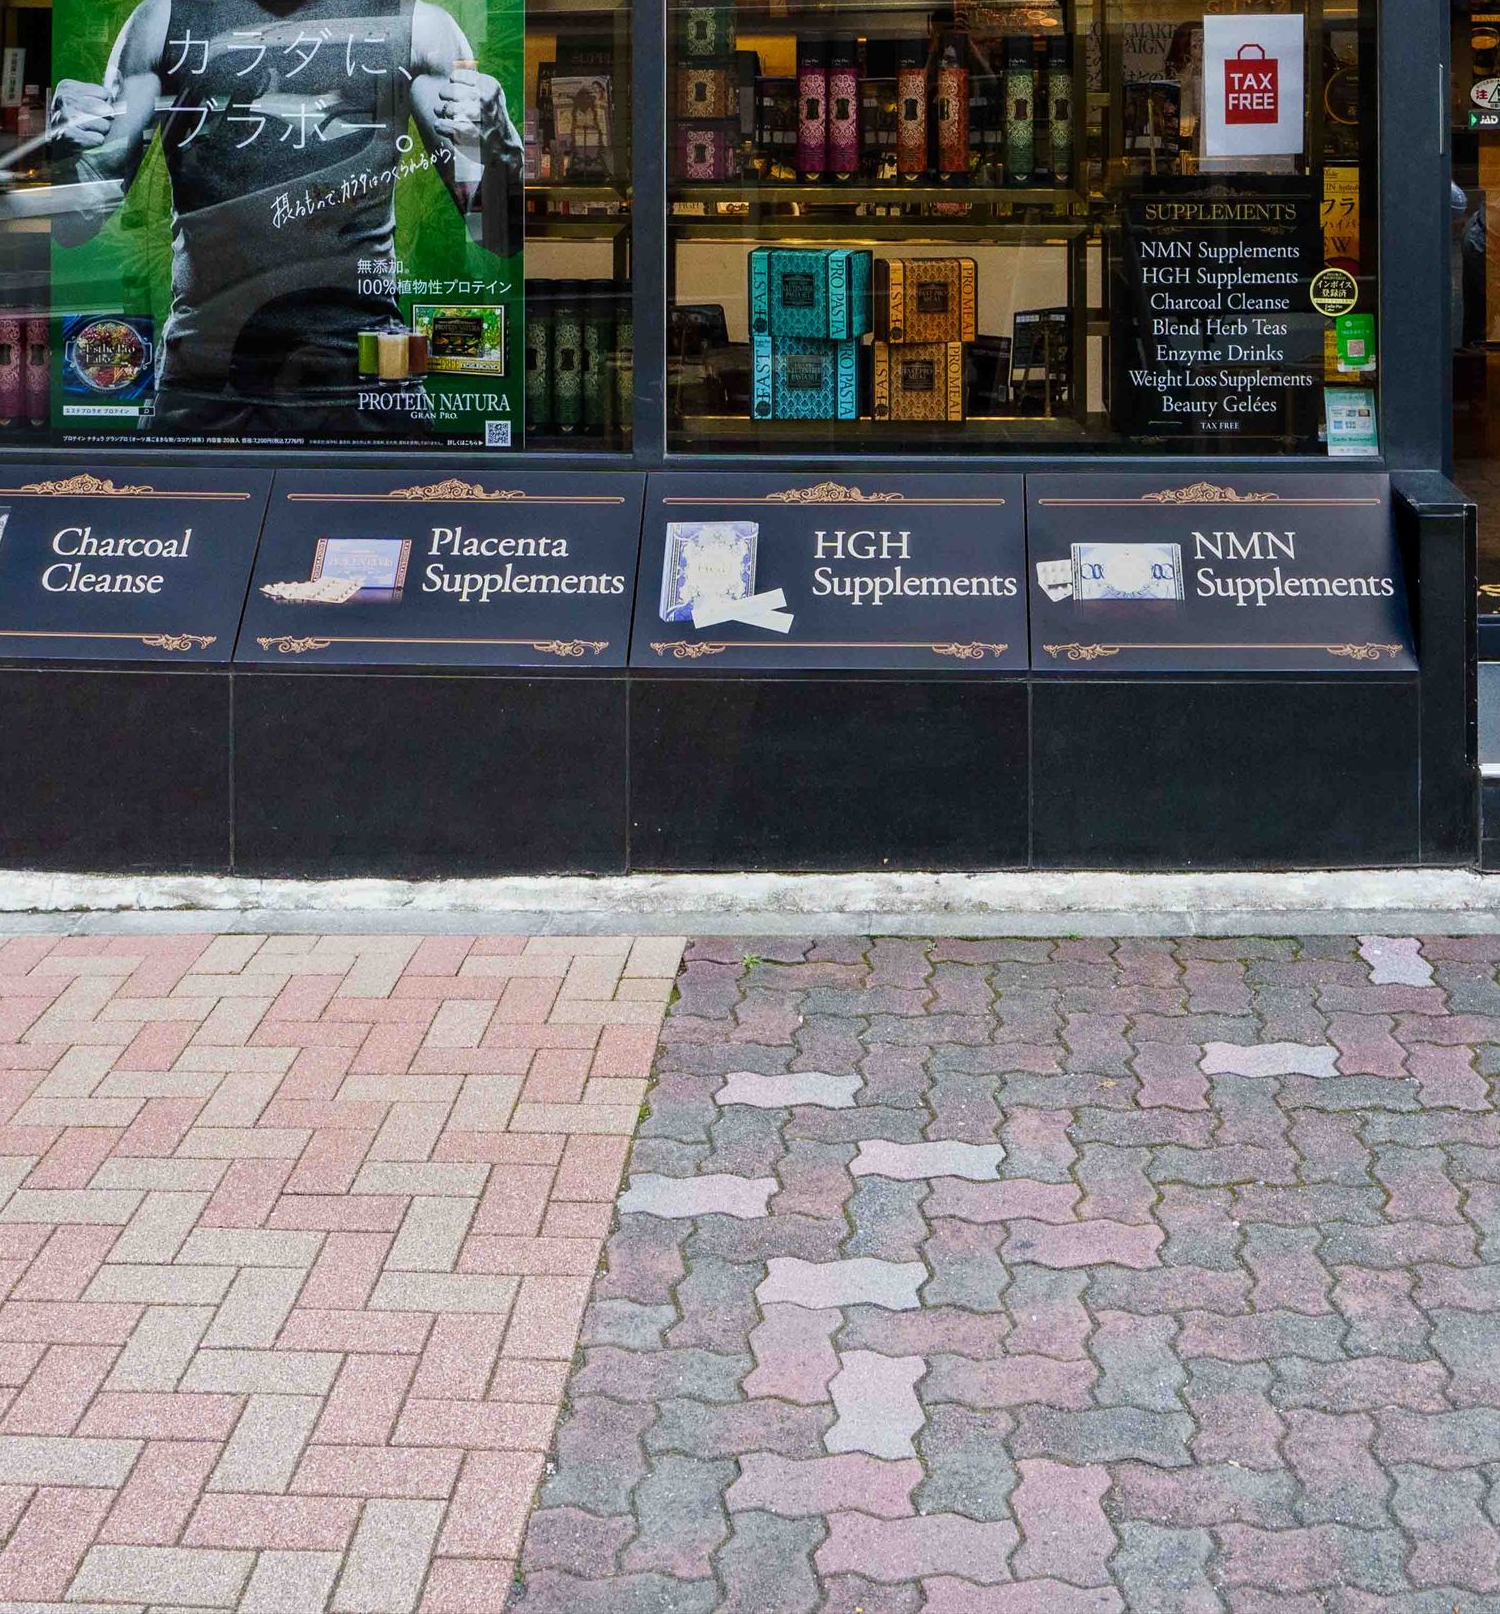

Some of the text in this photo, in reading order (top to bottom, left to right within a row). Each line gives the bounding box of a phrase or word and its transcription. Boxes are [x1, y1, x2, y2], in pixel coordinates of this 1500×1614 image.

[167, 28, 413, 81] カラダに、
[1229, 72, 1273, 90] TAX
[1228, 92, 1275, 110] FREE
[167, 98, 414, 153] ブラボー。
[1145, 203, 1297, 221] SUPPLEMENTS
[1140, 241, 1192, 259] NMN
[1198, 241, 1300, 264] Supplements
[357, 259, 410, 275] 無添加。
[1141, 267, 1299, 289] HGH Supplements
[357, 279, 512, 295] 100%植物性プロテイン
[1315, 279, 1353, 289] インボイス
[830, 258, 845, 336] PRO PASTA
[962, 266, 974, 341] PRO MEAL
[1150, 292, 1290, 310] Charcoal Cleanse
[1152, 318, 1288, 336] Blend Herb Teas
[1156, 344, 1284, 366] Enzyme Drinks
[757, 352, 772, 402] FAST
[948, 346, 960, 418] PRO MEAL
[1129, 369, 1313, 392] Weight Loss Supplements
[357, 392, 511, 412] PROTEIN NATURA
[840, 370, 854, 417] PASTA
[411, 411, 436, 420] GRAN
[1161, 394, 1277, 417] Beauty Gelées
[1200, 422, 1240, 430] TAX FREE
[51, 526, 192, 558] Charcoal
[426, 527, 570, 558] Placenta
[812, 530, 912, 561] HGH
[1192, 531, 1296, 561] NMN
[40, 563, 165, 595] Cleanse
[421, 563, 626, 604] Supplements
[811, 565, 1018, 607] Supplements
[1196, 566, 1395, 607] Supplements
